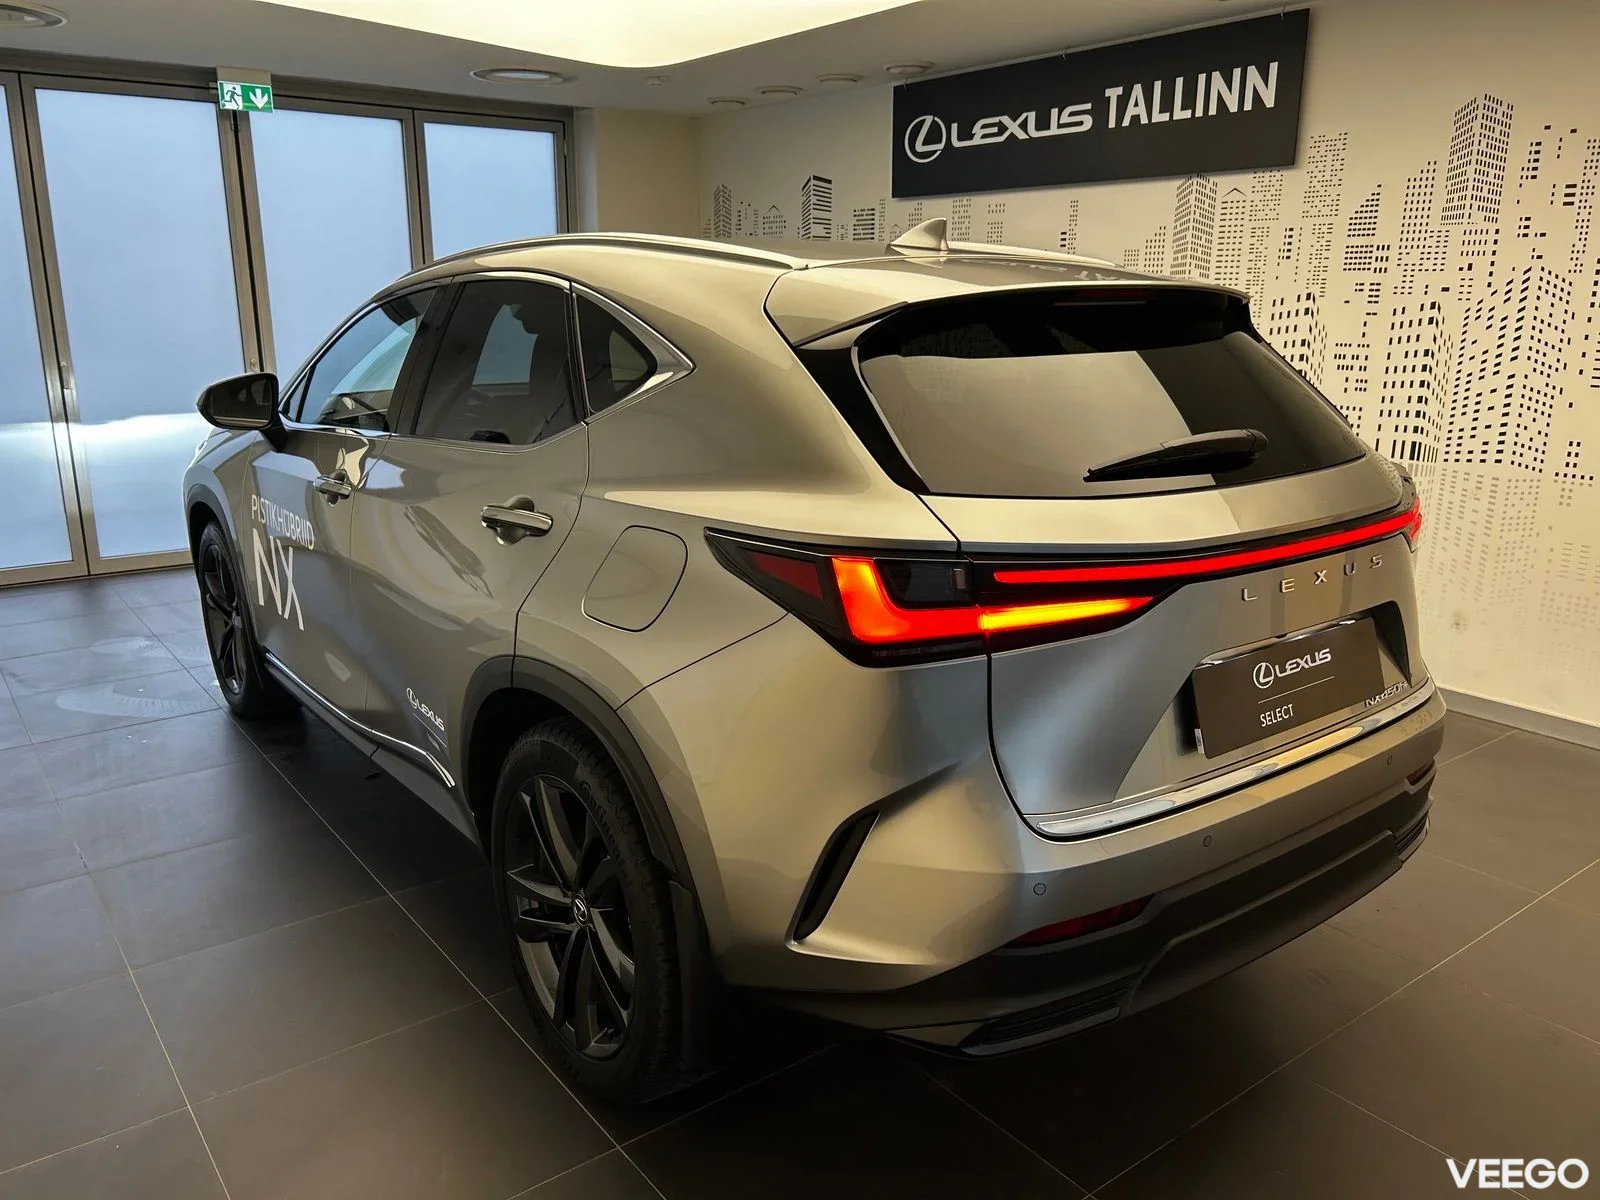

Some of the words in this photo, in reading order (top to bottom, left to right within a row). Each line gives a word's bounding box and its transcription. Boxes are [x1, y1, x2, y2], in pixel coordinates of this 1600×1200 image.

[951, 102, 1093, 148] LEXUS
[1104, 61, 1279, 129] TALLINN
[252, 527, 305, 632] NX
[1241, 554, 1383, 601] LEXUS
[1275, 648, 1332, 678] LEXUS
[416, 698, 445, 732] LEXUS
[1260, 703, 1294, 728] SELECT
